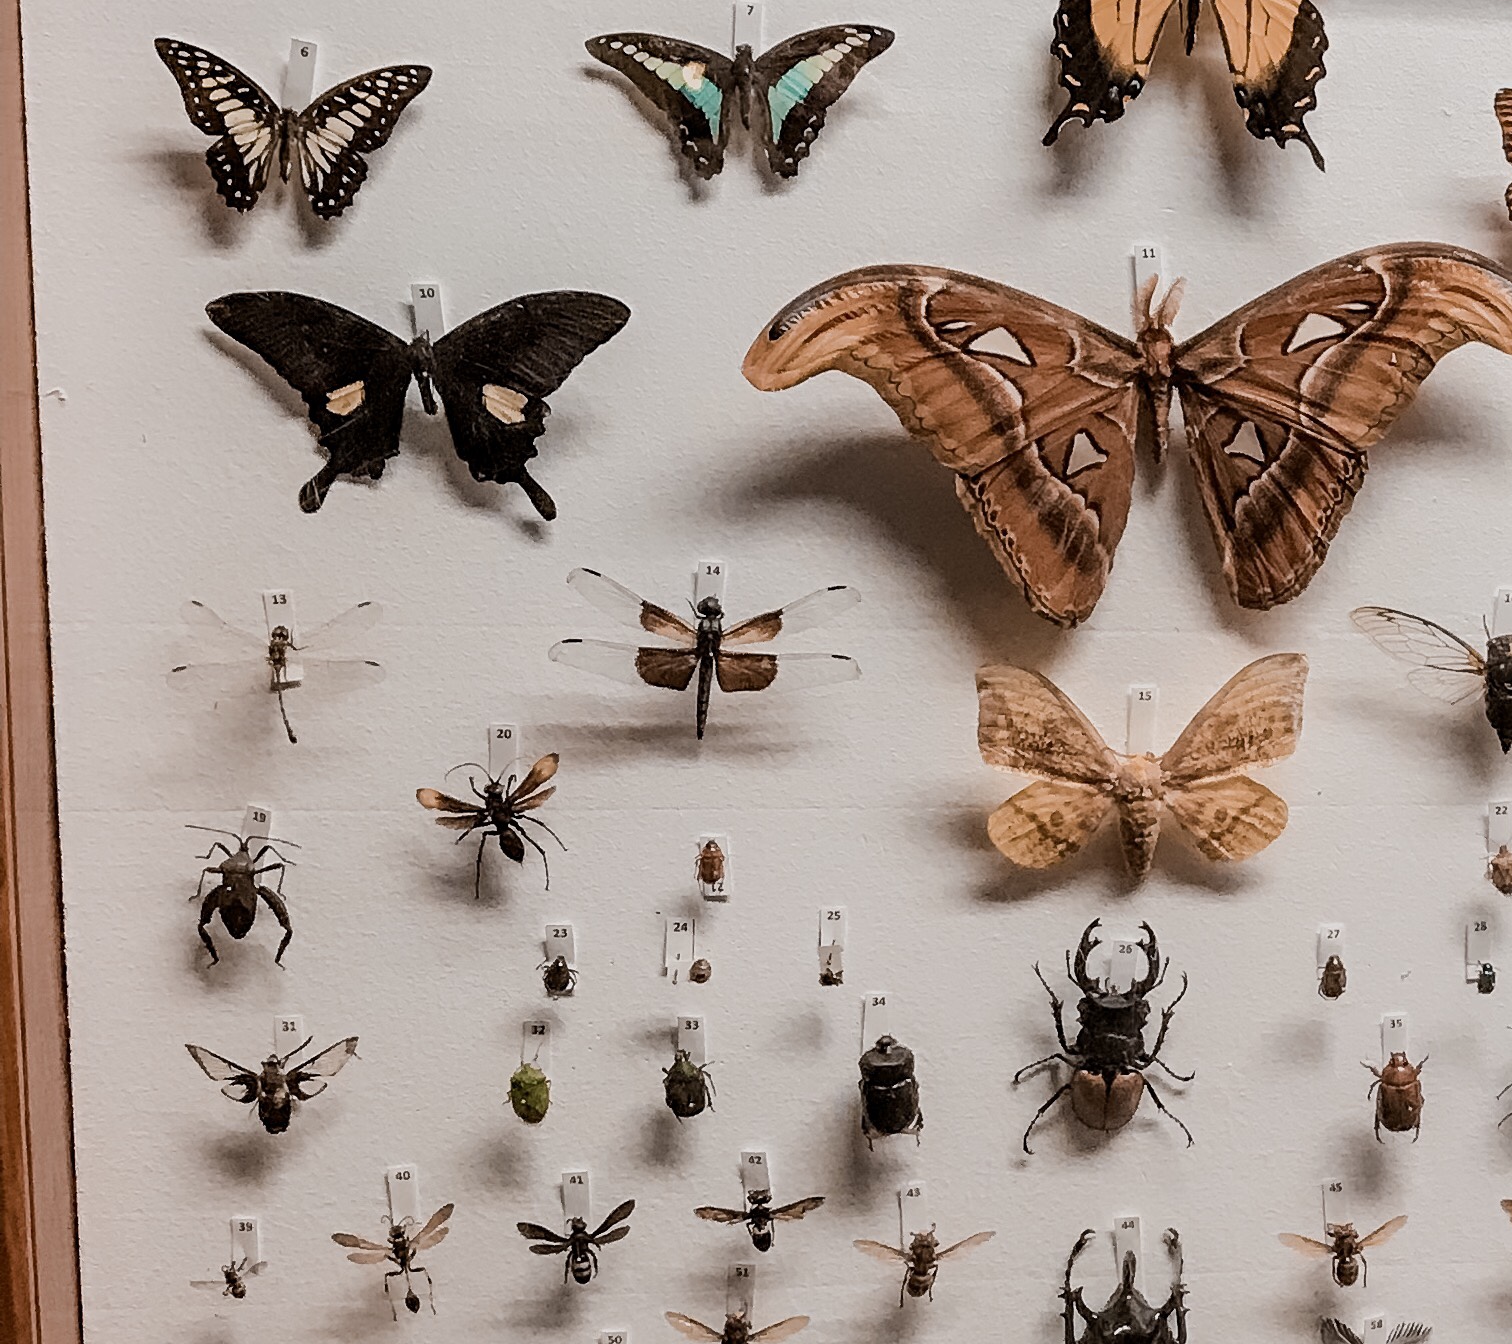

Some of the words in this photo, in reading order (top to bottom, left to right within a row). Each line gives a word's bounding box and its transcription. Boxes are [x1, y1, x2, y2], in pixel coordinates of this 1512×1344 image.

[747, 4, 754, 16] 7
[300, 46, 309, 58] 6
[1142, 248, 1156, 259] 11
[419, 287, 435, 299] 10
[706, 565, 721, 576] 14
[272, 594, 287, 605] 13
[1138, 691, 1152, 701] 15
[496, 728, 512, 740] 20
[1495, 805, 1508, 816] 22
[827, 910, 841, 921] 25
[673, 922, 688, 932] 24
[552, 928, 568, 939] 23
[1327, 929, 1340, 939] 27
[872, 996, 886, 1007] 34
[282, 1021, 296, 1032] 31
[684, 1020, 700, 1031] 33
[1389, 1018, 1403, 1029] 35
[748, 1155, 763, 1165] 42
[395, 1170, 411, 1181] 40
[569, 1175, 584, 1185] 41
[607, 1335, 623, 1344] 50
